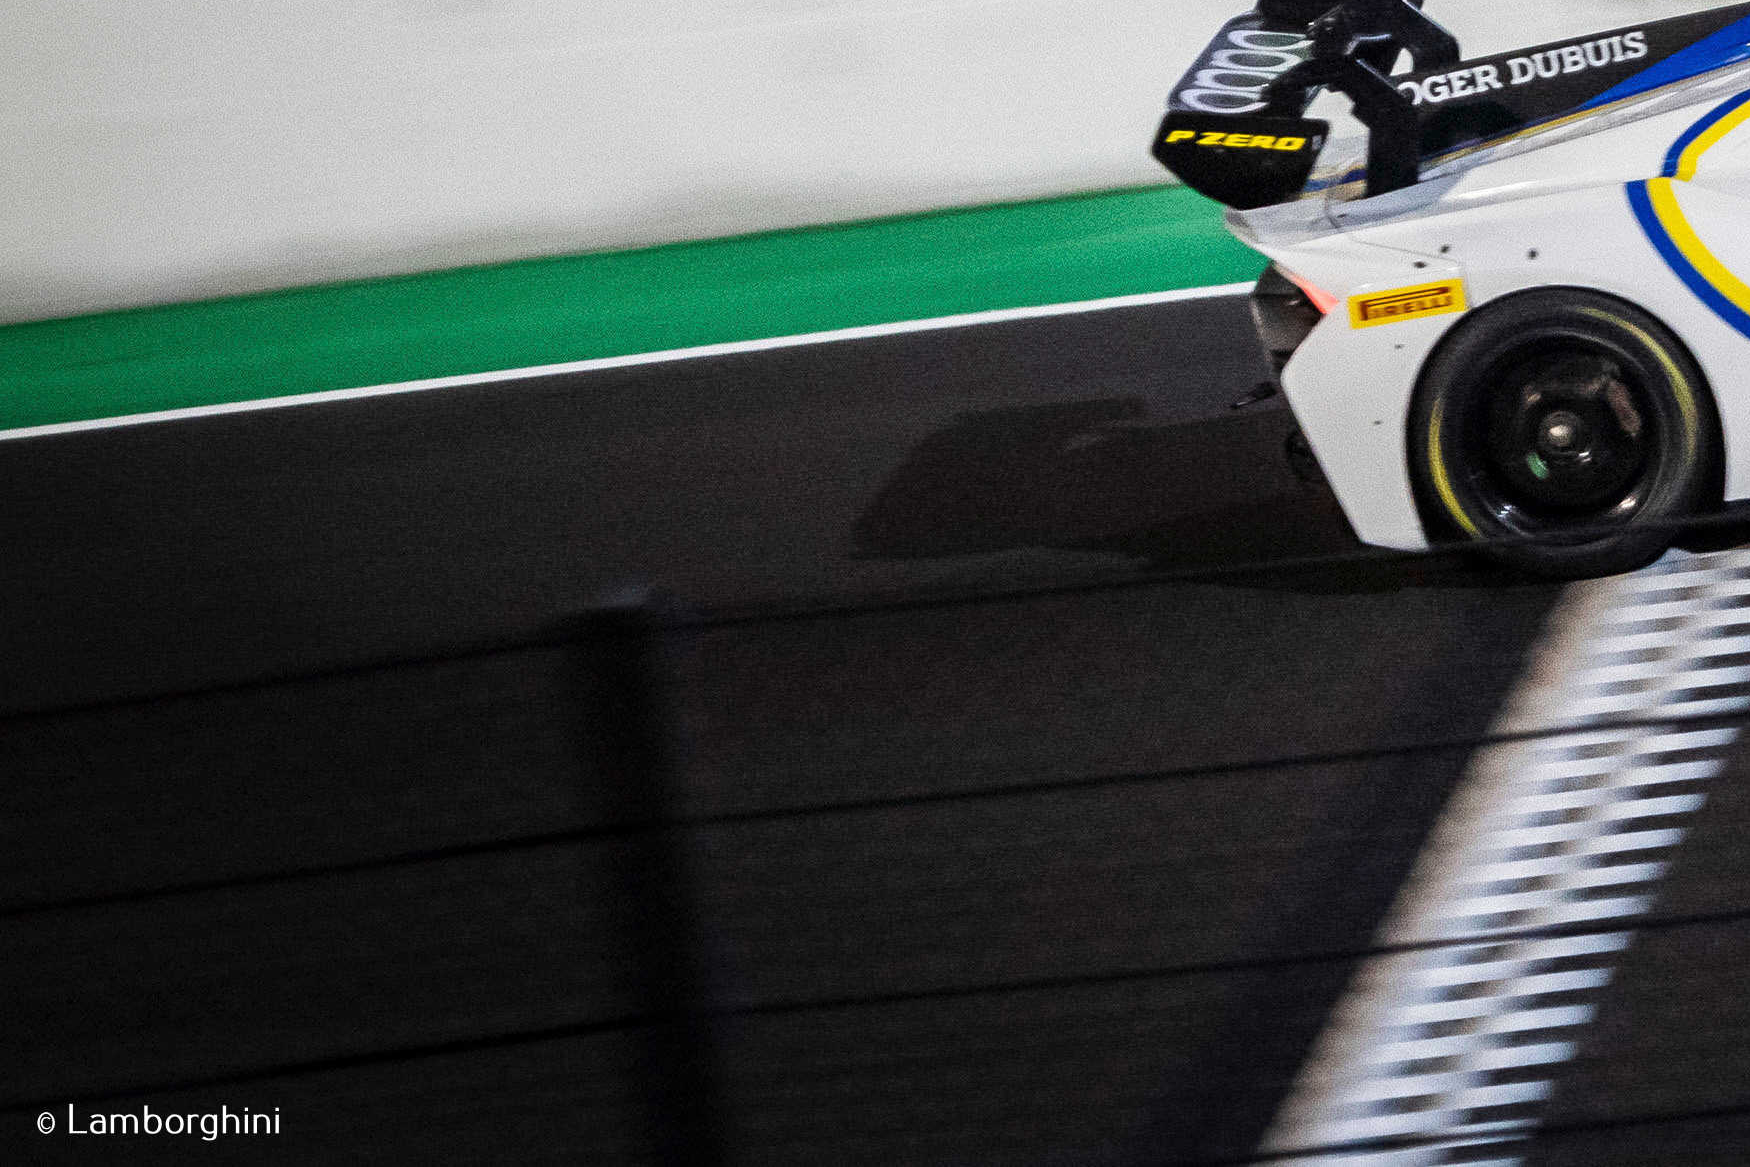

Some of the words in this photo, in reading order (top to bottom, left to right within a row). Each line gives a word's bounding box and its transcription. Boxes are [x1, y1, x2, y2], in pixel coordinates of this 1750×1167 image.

[1397, 63, 1503, 106] OGER
[1507, 31, 1648, 85] DUBUIS
[1165, 130, 1196, 144] P
[1196, 131, 1307, 152] ZERO
[1358, 286, 1452, 321] PIRELLI
